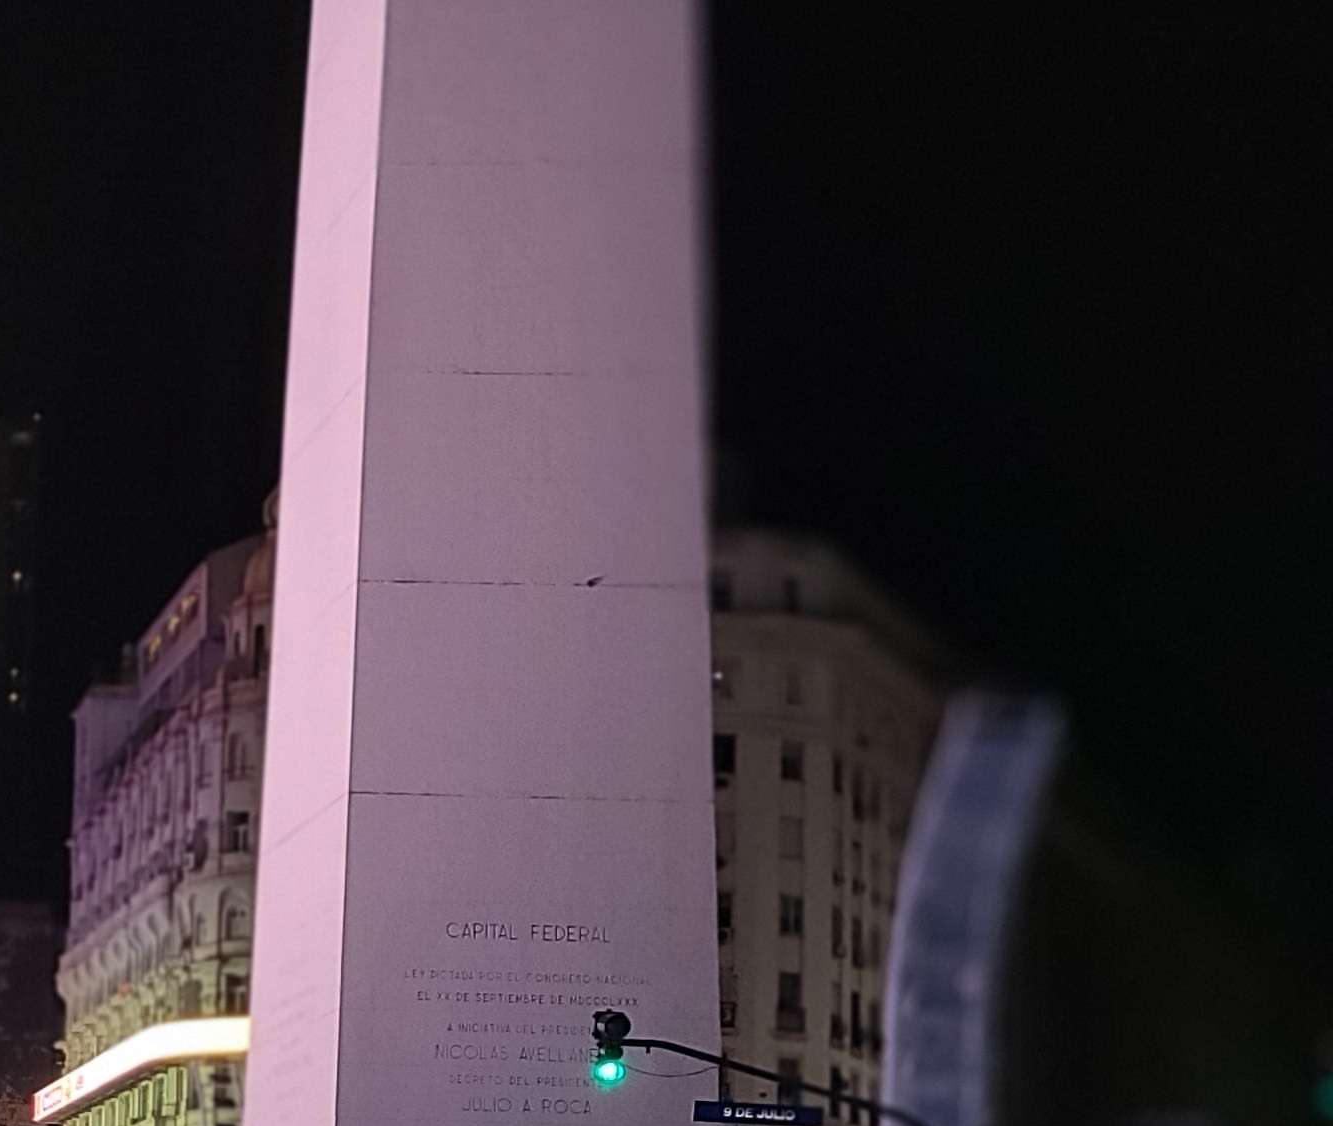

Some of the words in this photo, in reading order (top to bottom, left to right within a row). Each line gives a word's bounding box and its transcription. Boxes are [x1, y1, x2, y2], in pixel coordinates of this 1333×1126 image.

[445, 921, 518, 941] CAPITAL
[530, 924, 611, 943] FEDERAL
[525, 973, 591, 984] CONGRESO
[417, 990, 431, 1001] EL
[456, 992, 470, 1002] DE
[475, 992, 545, 1005] SEPTIEMBRE
[550, 994, 565, 1005] DE
[446, 1023, 453, 1032] A
[458, 1022, 511, 1033] INICIATIVA
[540, 1025, 591, 1036] PRESIDE
[434, 1043, 509, 1061] NICOLAS
[519, 1046, 598, 1063] AVELLANE
[448, 1073, 503, 1086] DECRETO
[509, 1075, 530, 1087] DEL
[537, 1076, 591, 1088] PRESIDEN
[462, 1097, 512, 1113] JULIO
[522, 1098, 532, 1112] A
[541, 1098, 592, 1114] ROCA
[722, 1106, 732, 1117] 9
[735, 1107, 754, 1119] DE
[756, 1108, 796, 1121] JULIO
